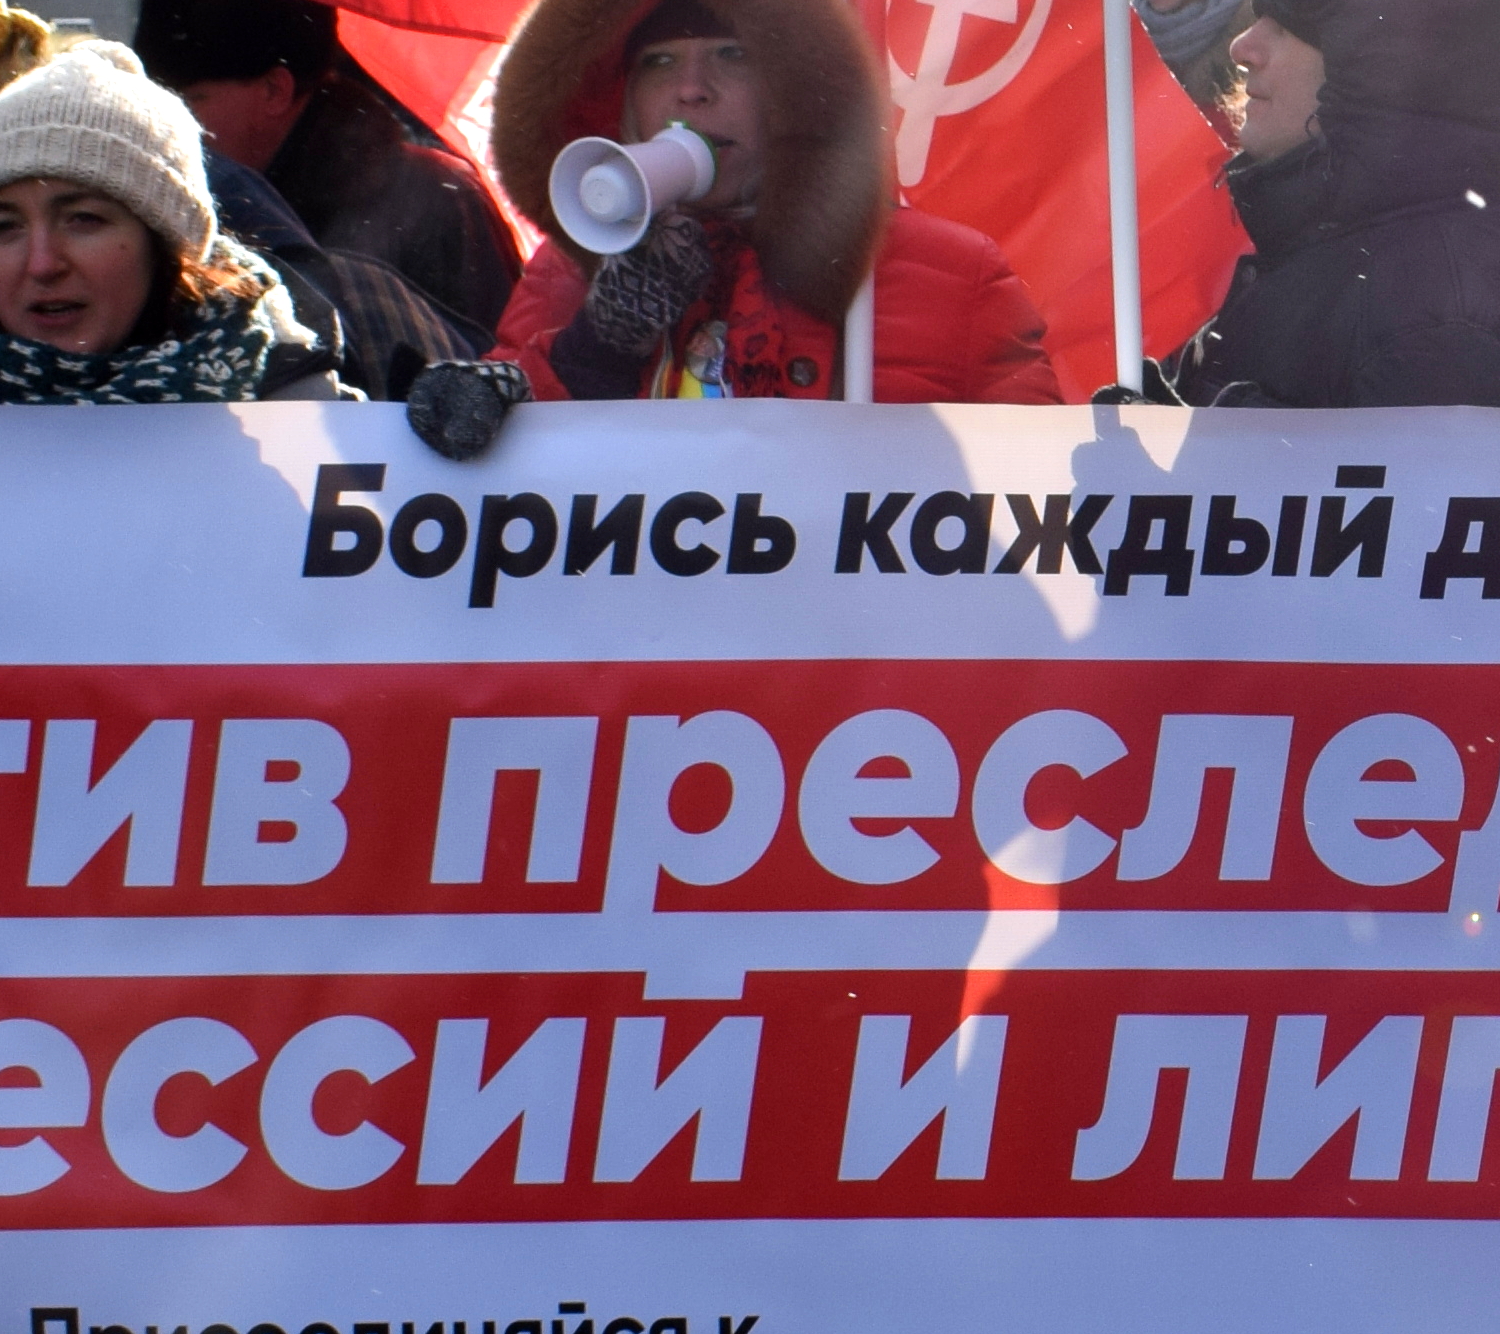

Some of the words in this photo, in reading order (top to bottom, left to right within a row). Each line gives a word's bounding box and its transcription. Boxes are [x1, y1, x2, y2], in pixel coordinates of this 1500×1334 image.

[303, 459, 796, 608] Борись
[835, 466, 1394, 596] каждый
[837, 1013, 1009, 1184] и
